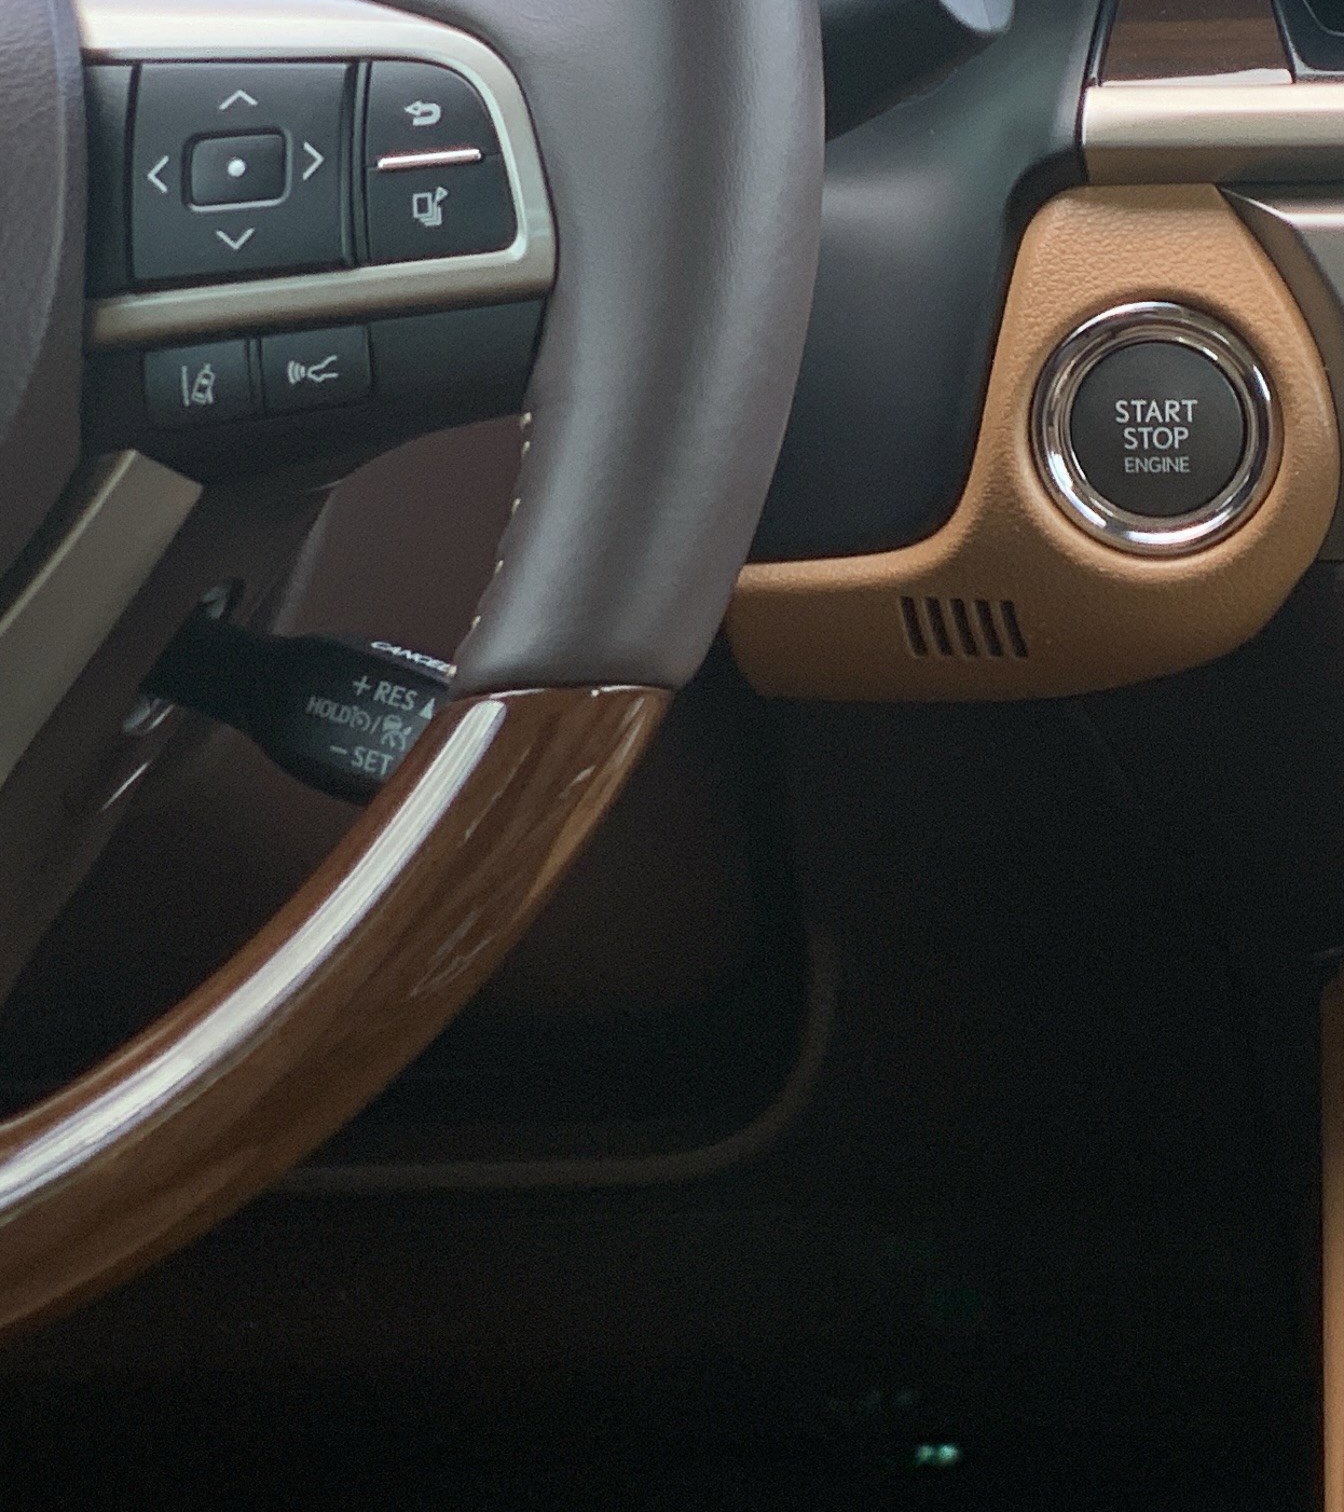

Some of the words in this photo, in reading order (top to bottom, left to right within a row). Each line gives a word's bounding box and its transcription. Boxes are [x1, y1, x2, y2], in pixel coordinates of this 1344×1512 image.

[1115, 399, 1198, 424] START
[1123, 426, 1189, 450] STOP
[1124, 456, 1192, 474] ENGINE
[306, 696, 355, 722] HOLD
